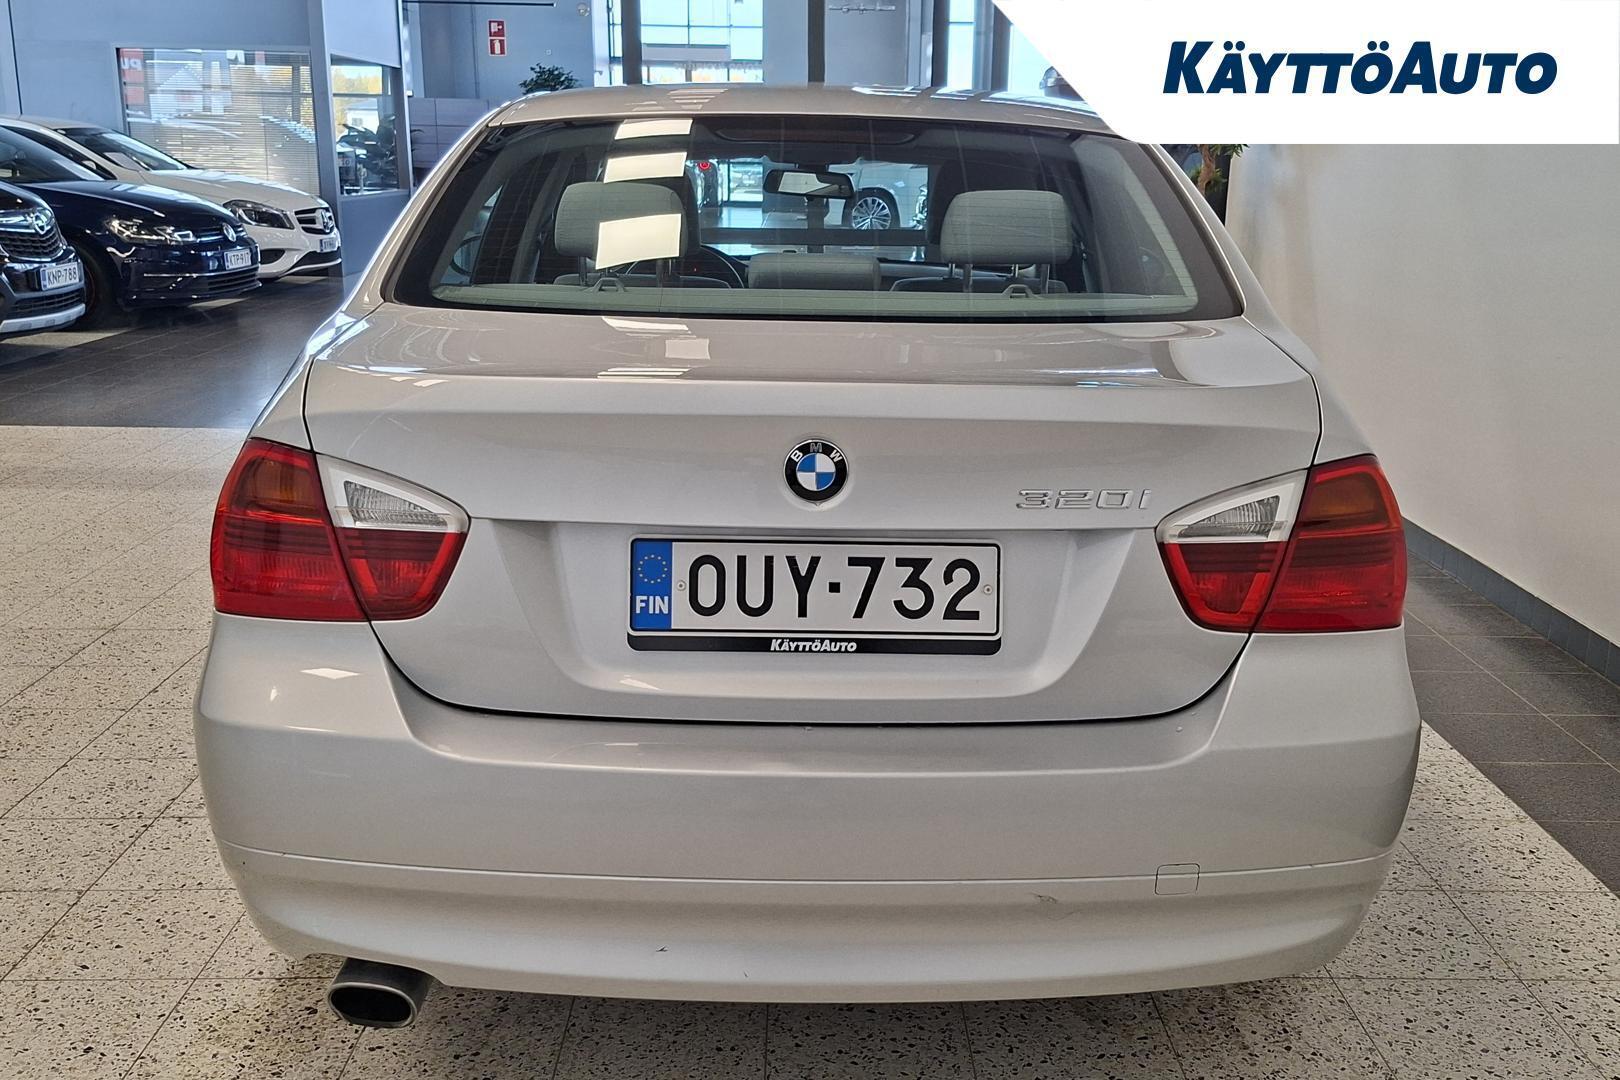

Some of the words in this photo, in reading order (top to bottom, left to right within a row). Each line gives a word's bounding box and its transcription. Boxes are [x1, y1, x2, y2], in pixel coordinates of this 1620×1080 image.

[47, 266, 77, 285] KNP-788
[790, 442, 843, 462] BMW
[688, 554, 981, 620] OUY-732
[635, 595, 669, 614] FIN
